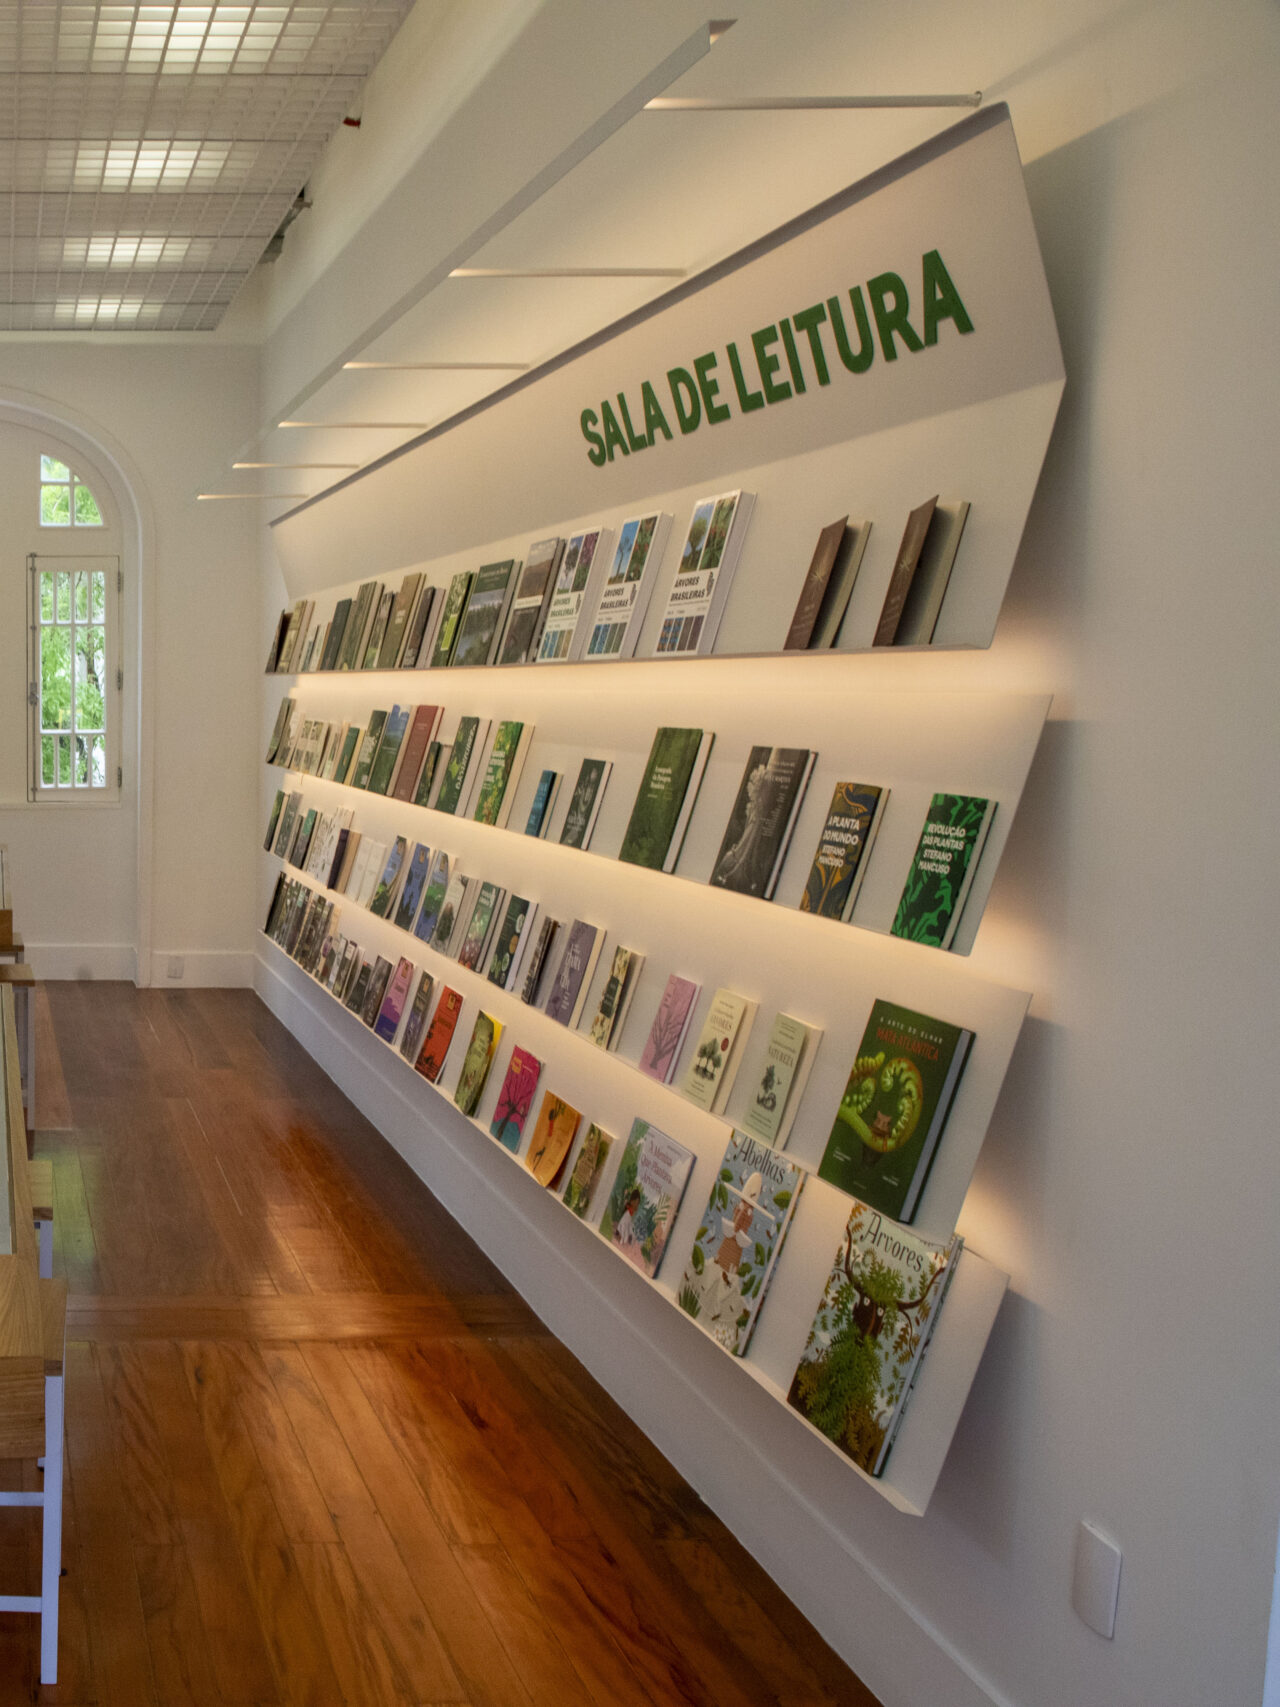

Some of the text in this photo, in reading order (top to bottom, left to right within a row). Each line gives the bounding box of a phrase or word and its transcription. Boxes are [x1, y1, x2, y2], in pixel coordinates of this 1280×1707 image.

[580, 248, 975, 467] SALA DE LEITURA
[833, 816, 860, 831] PLANTA
[928, 823, 966, 838] REVOLUÇÃO
[823, 830, 859, 845] DO MUNDO
[922, 835, 964, 850] DAS PLANTAS
[822, 844, 846, 857] STEFANO
[923, 849, 952, 862] STEFANO
[918, 860, 950, 874] MANCUSO
[876, 1026, 896, 1044] MATA
[733, 1136, 786, 1184] Abelhas
